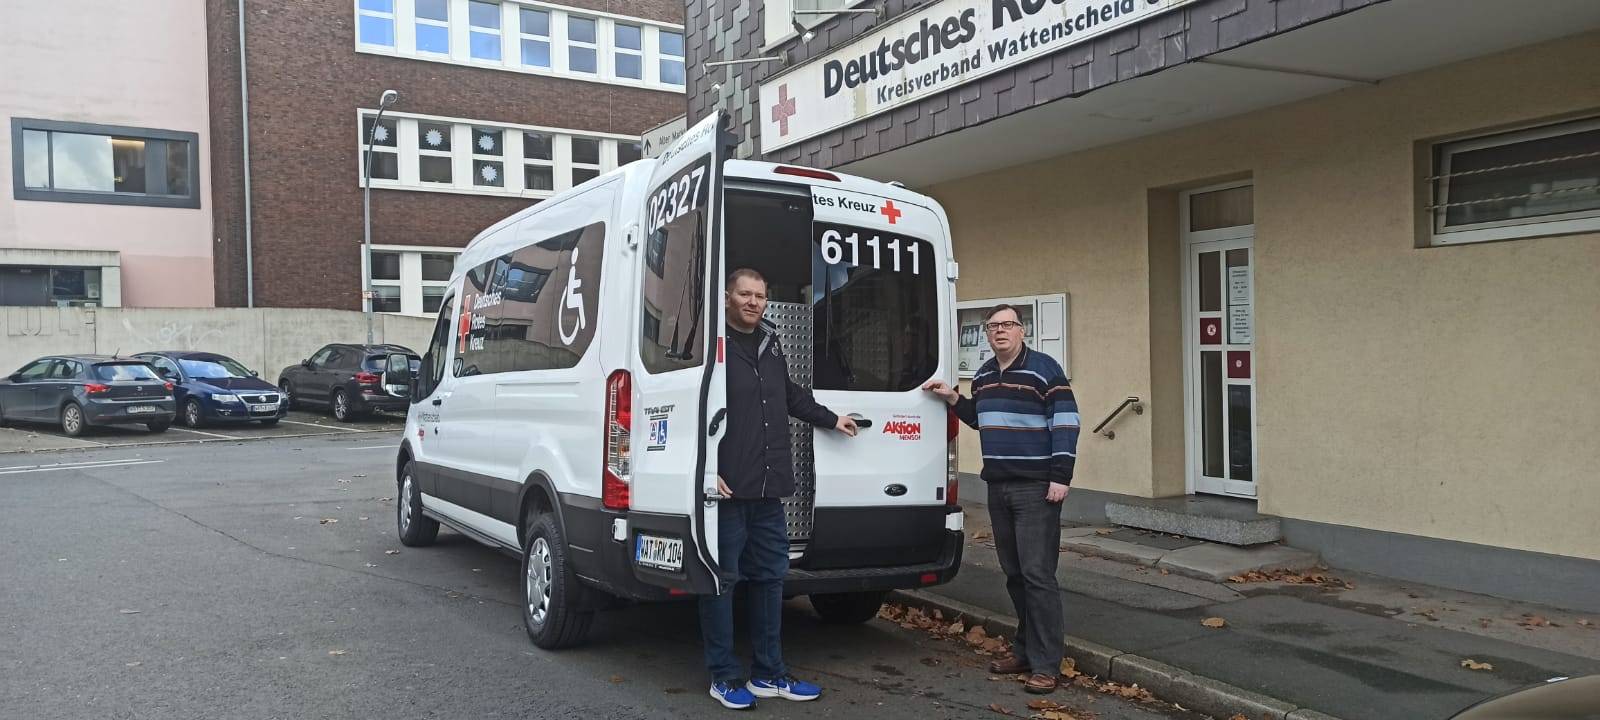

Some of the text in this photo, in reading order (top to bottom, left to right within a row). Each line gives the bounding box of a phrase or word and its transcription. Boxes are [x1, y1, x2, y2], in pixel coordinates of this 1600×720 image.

[823, 8, 976, 98] Deutsches
[877, 0, 1134, 105] Kreisverband Wattenscheid
[649, 165, 705, 235] 02327
[838, 196, 877, 213] Kreuz
[821, 229, 920, 275] 61111
[474, 289, 502, 310] Deutsches
[471, 313, 486, 330] Rotes
[470, 333, 484, 351] Kreuz
